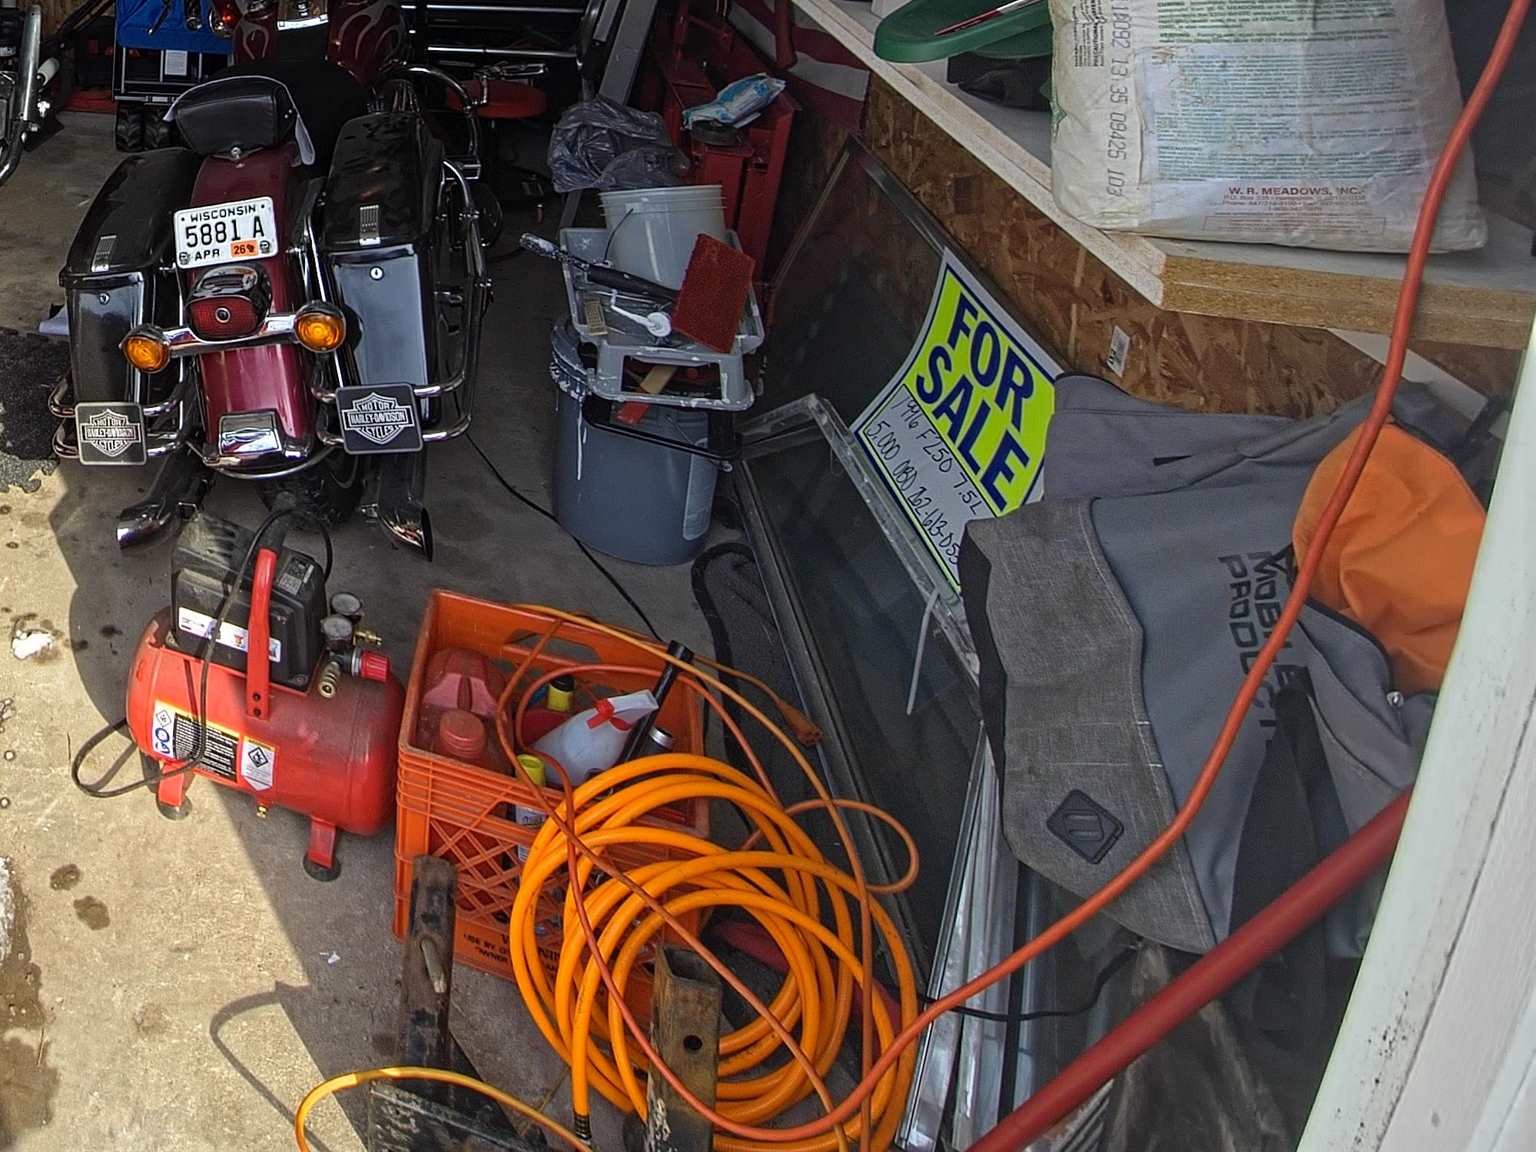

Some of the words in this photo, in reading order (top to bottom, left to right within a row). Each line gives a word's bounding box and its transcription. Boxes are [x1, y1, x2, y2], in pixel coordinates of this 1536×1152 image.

[1107, 111, 1127, 161] 09425
[1106, 168, 1126, 197] 103
[1228, 187, 1242, 195] W.
[190, 204, 257, 223] WISCONSIN
[185, 219, 241, 248] 5881
[253, 215, 265, 238] A
[194, 248, 221, 262] APR
[233, 244, 246, 255] 26
[948, 293, 1034, 432] FOR
[361, 399, 390, 410] MOTOR
[350, 411, 405, 424] HARLEY-DAVIDSON
[916, 345, 1030, 512] SALE
[916, 429, 954, 474] F250
